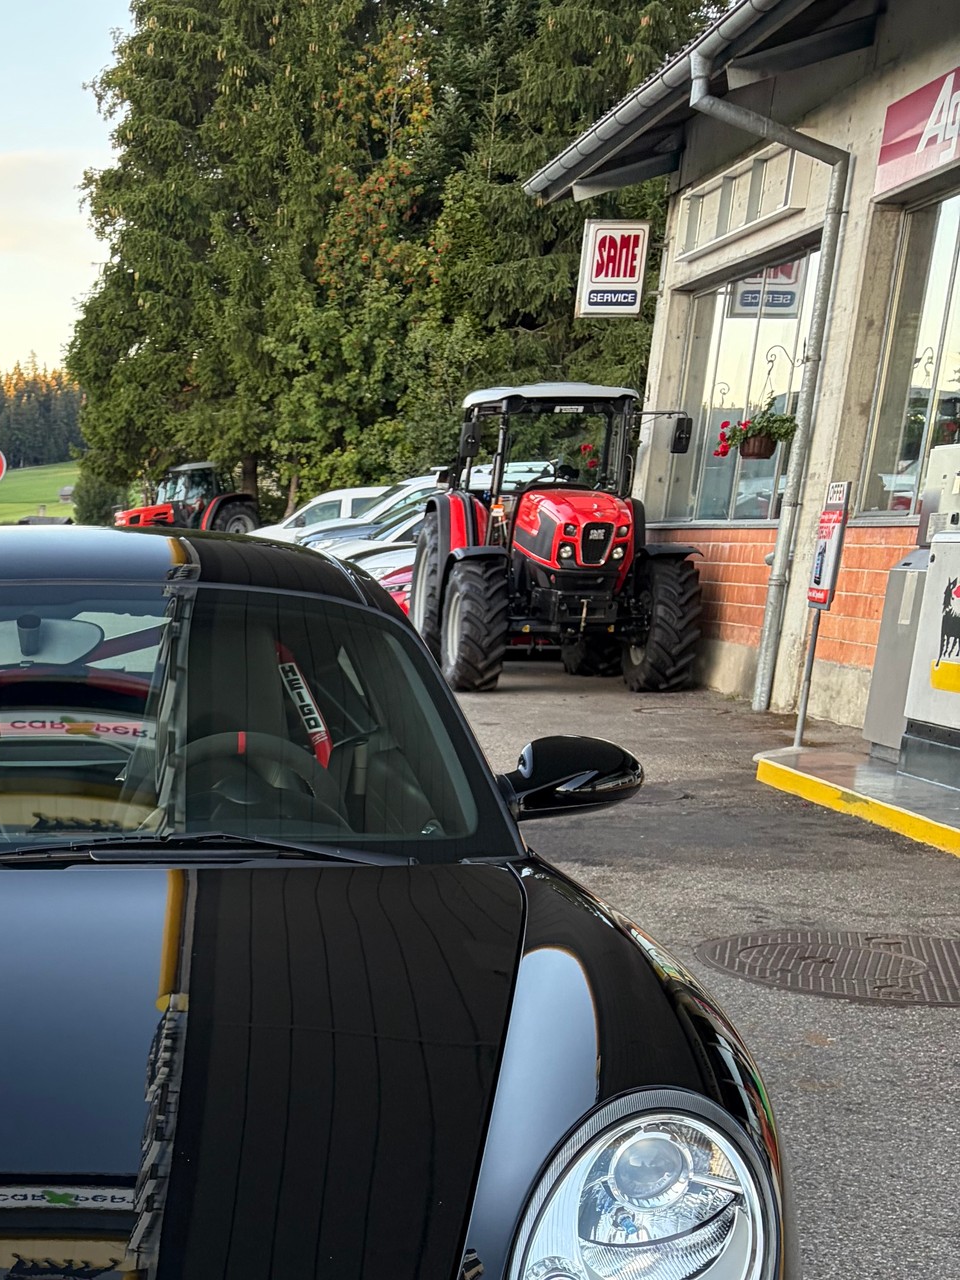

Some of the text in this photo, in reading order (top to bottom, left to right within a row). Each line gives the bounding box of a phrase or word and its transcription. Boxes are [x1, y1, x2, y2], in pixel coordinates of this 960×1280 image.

[594, 234, 641, 278] SAME
[589, 293, 636, 303] SERVICE
[280, 664, 322, 730] HEIGO
